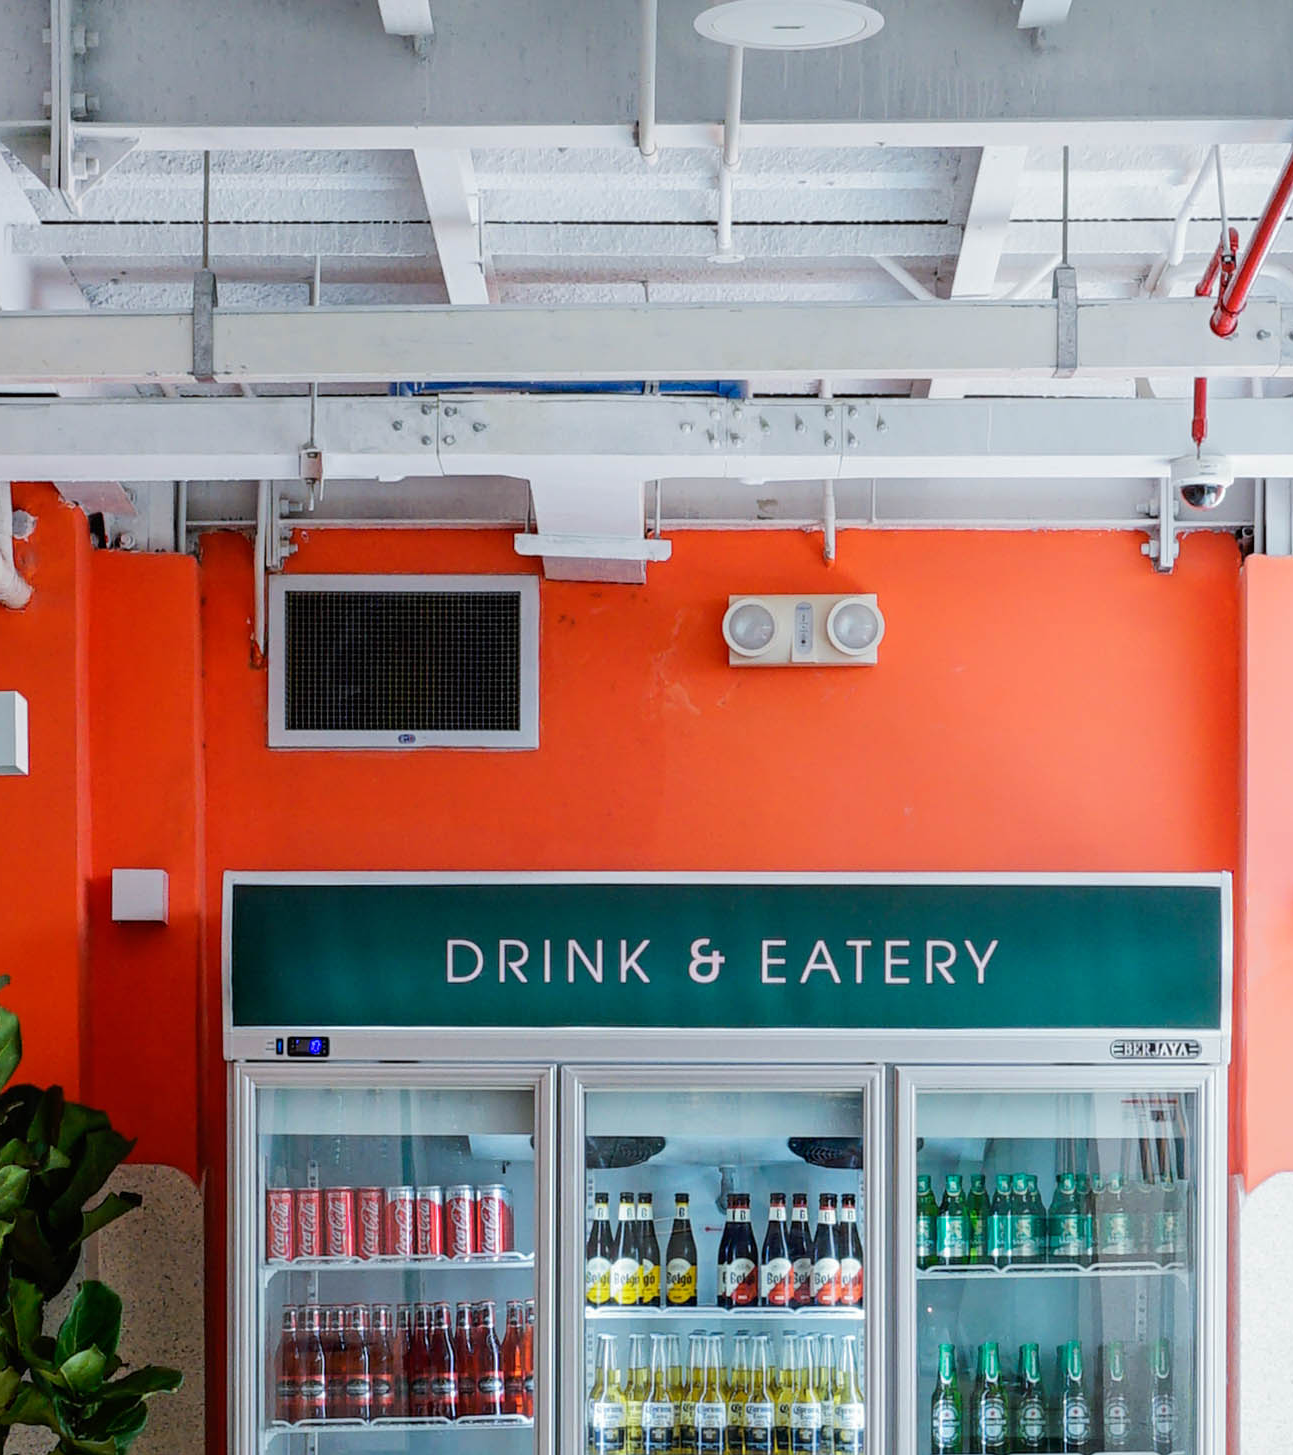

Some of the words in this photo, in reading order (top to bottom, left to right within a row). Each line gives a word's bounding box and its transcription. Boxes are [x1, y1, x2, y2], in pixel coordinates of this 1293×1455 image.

[446, 939, 650, 983] DRINK
[688, 938, 725, 984] &
[761, 939, 998, 984] EATERY
[1123, 1043, 1189, 1057] BERJAYA
